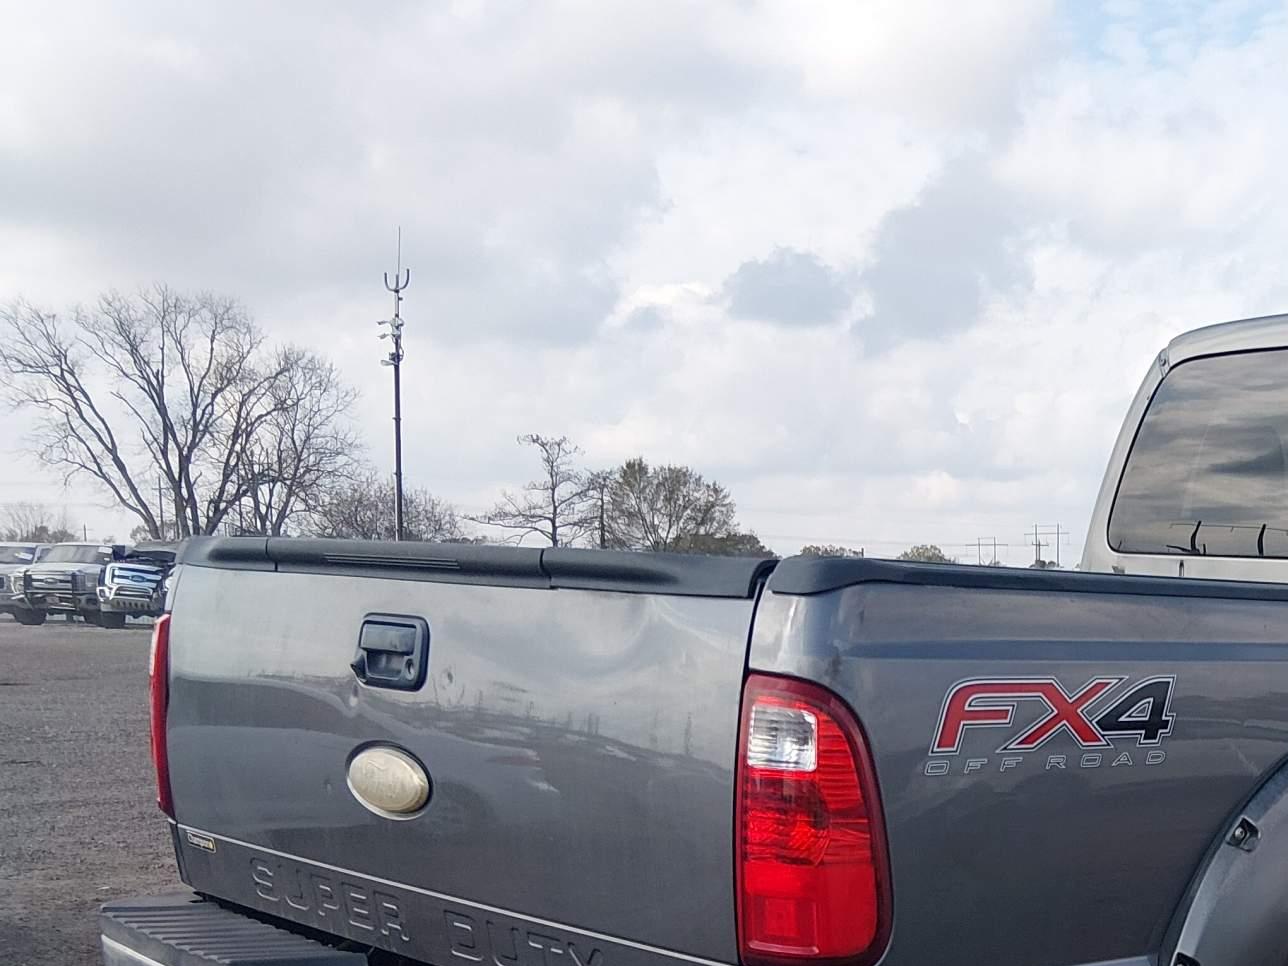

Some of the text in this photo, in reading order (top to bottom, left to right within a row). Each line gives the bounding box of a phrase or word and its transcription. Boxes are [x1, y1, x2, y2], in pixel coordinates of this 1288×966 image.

[928, 674, 1177, 756] FX4
[924, 750, 1167, 776] OFF ROAD
[250, 857, 411, 942] SUPER
